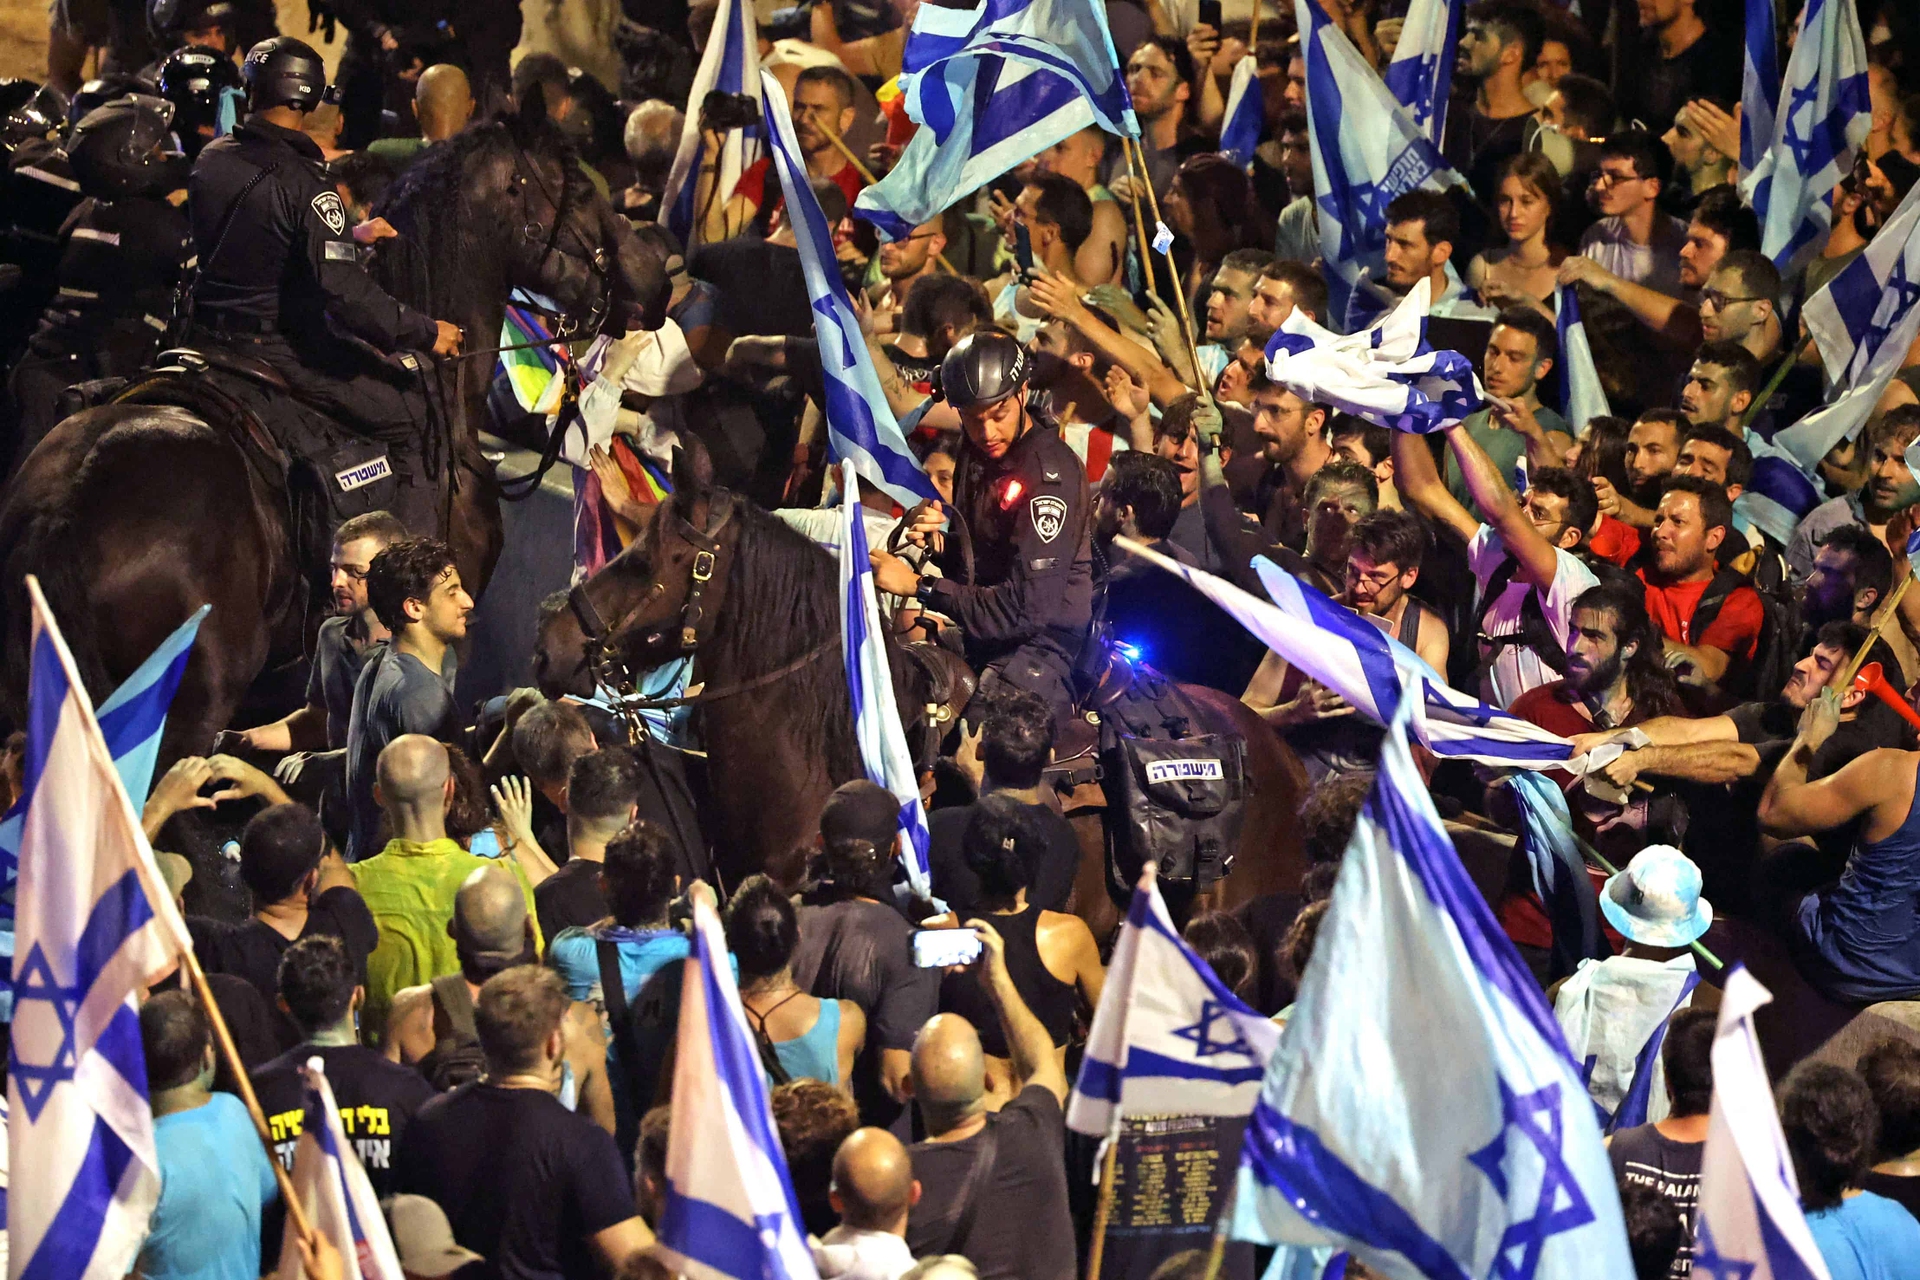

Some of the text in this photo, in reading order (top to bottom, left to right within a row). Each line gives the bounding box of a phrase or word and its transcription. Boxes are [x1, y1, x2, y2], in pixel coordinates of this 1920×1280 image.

[340, 460, 387, 488] משטרה
[1152, 763, 1217, 780] משטרה
[356, 1104, 391, 1135] בלי
